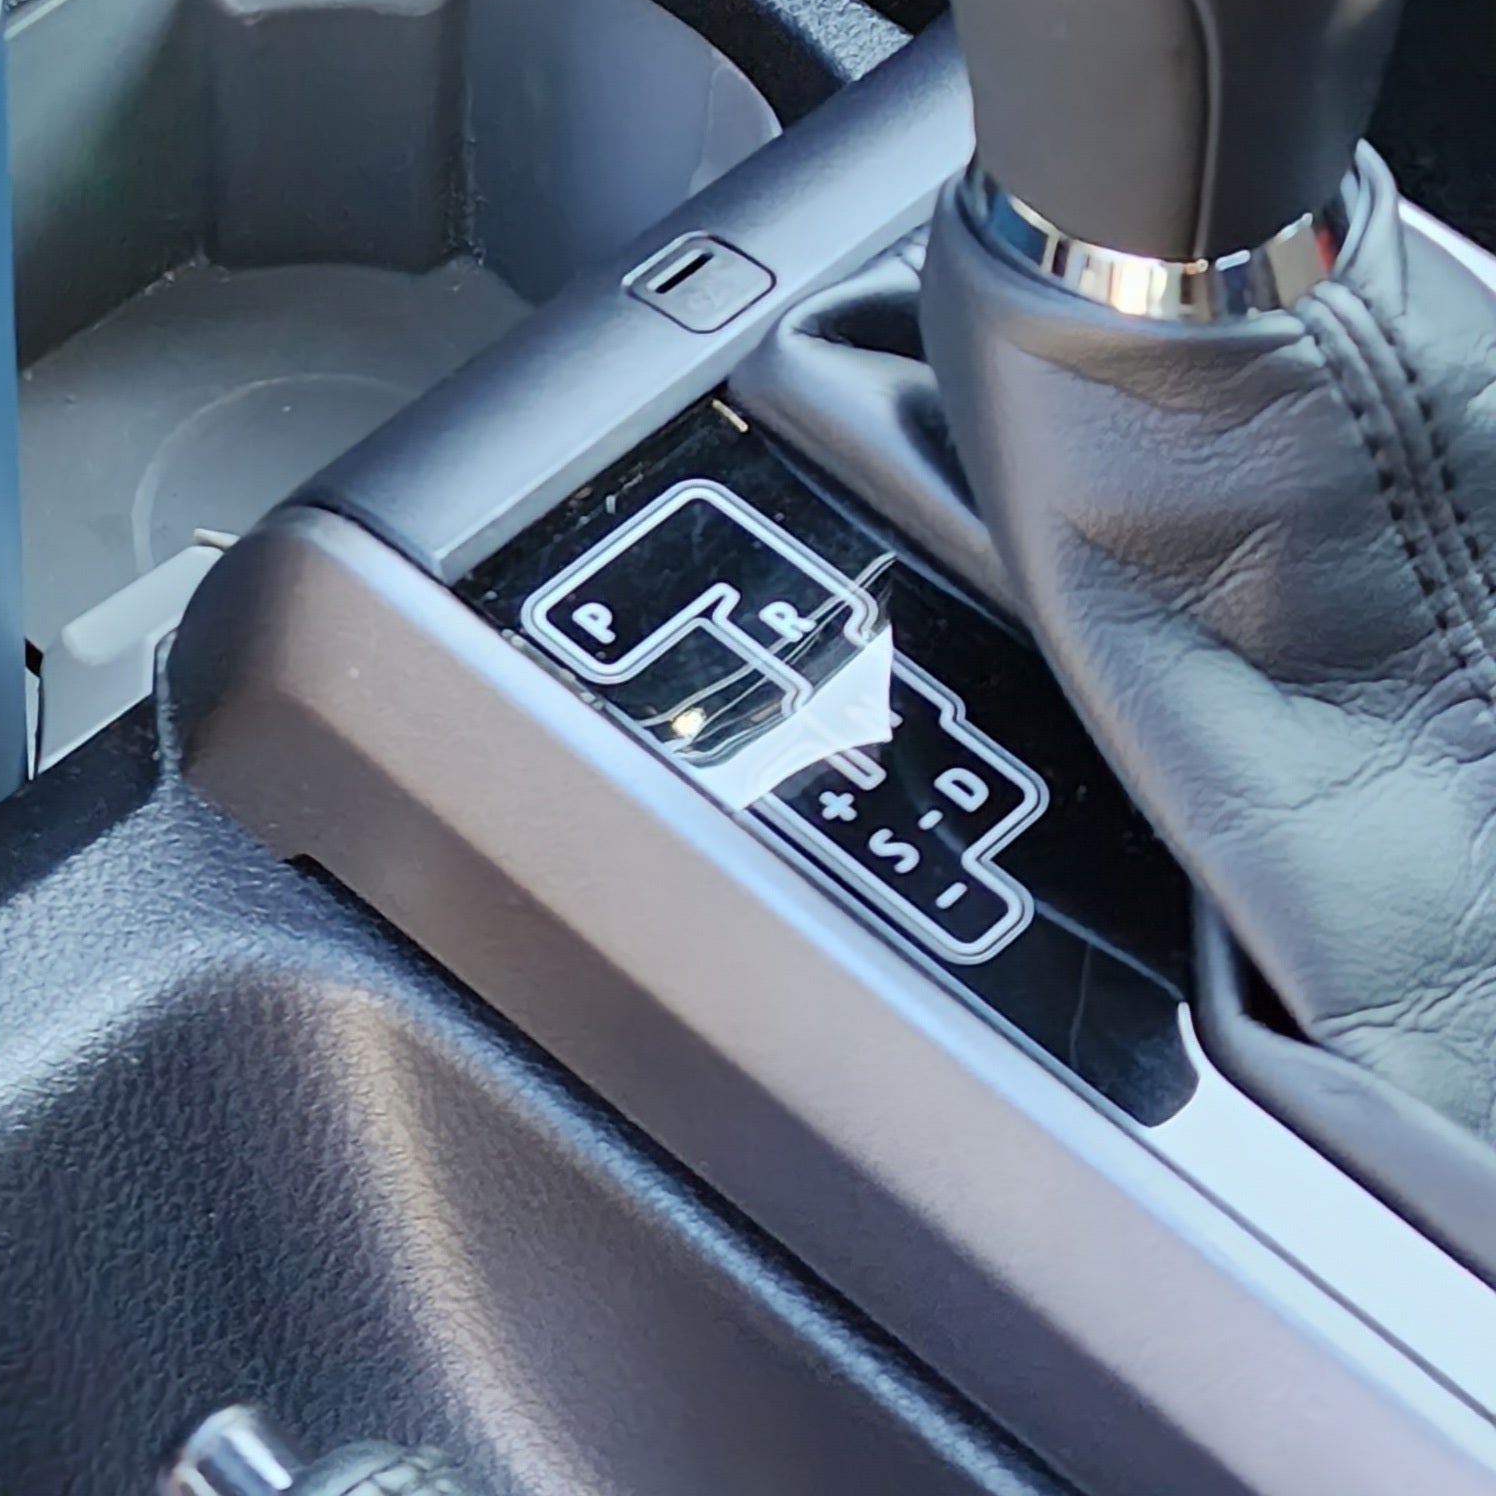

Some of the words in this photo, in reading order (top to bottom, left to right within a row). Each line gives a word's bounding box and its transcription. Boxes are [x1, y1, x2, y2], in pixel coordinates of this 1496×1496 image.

[571, 602, 616, 644] P
[759, 601, 817, 643] R
[868, 827, 920, 874] S
[934, 767, 990, 813] D
